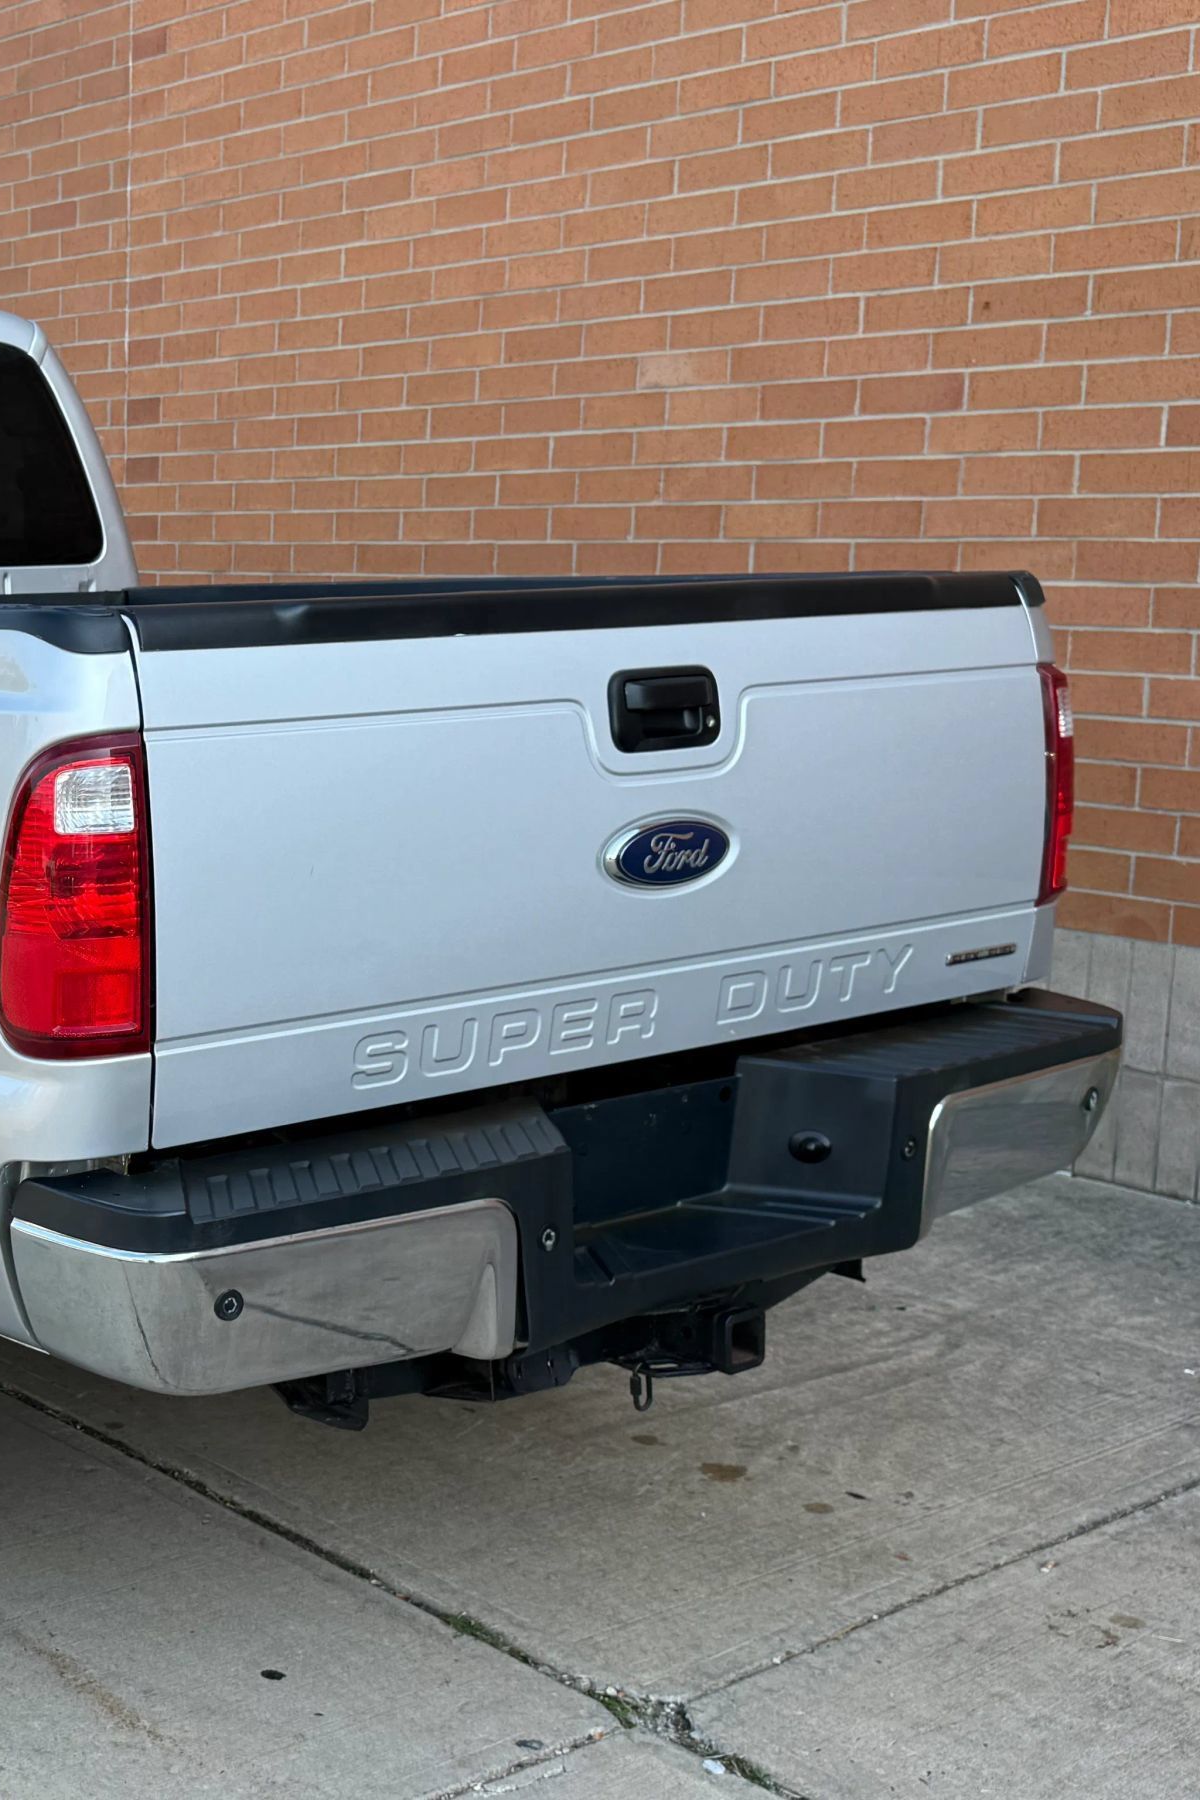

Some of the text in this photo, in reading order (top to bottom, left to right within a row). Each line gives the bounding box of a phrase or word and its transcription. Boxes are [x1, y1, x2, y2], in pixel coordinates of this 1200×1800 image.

[644, 832, 709, 873] Ford
[352, 945, 913, 1089] SUPER DUTY
